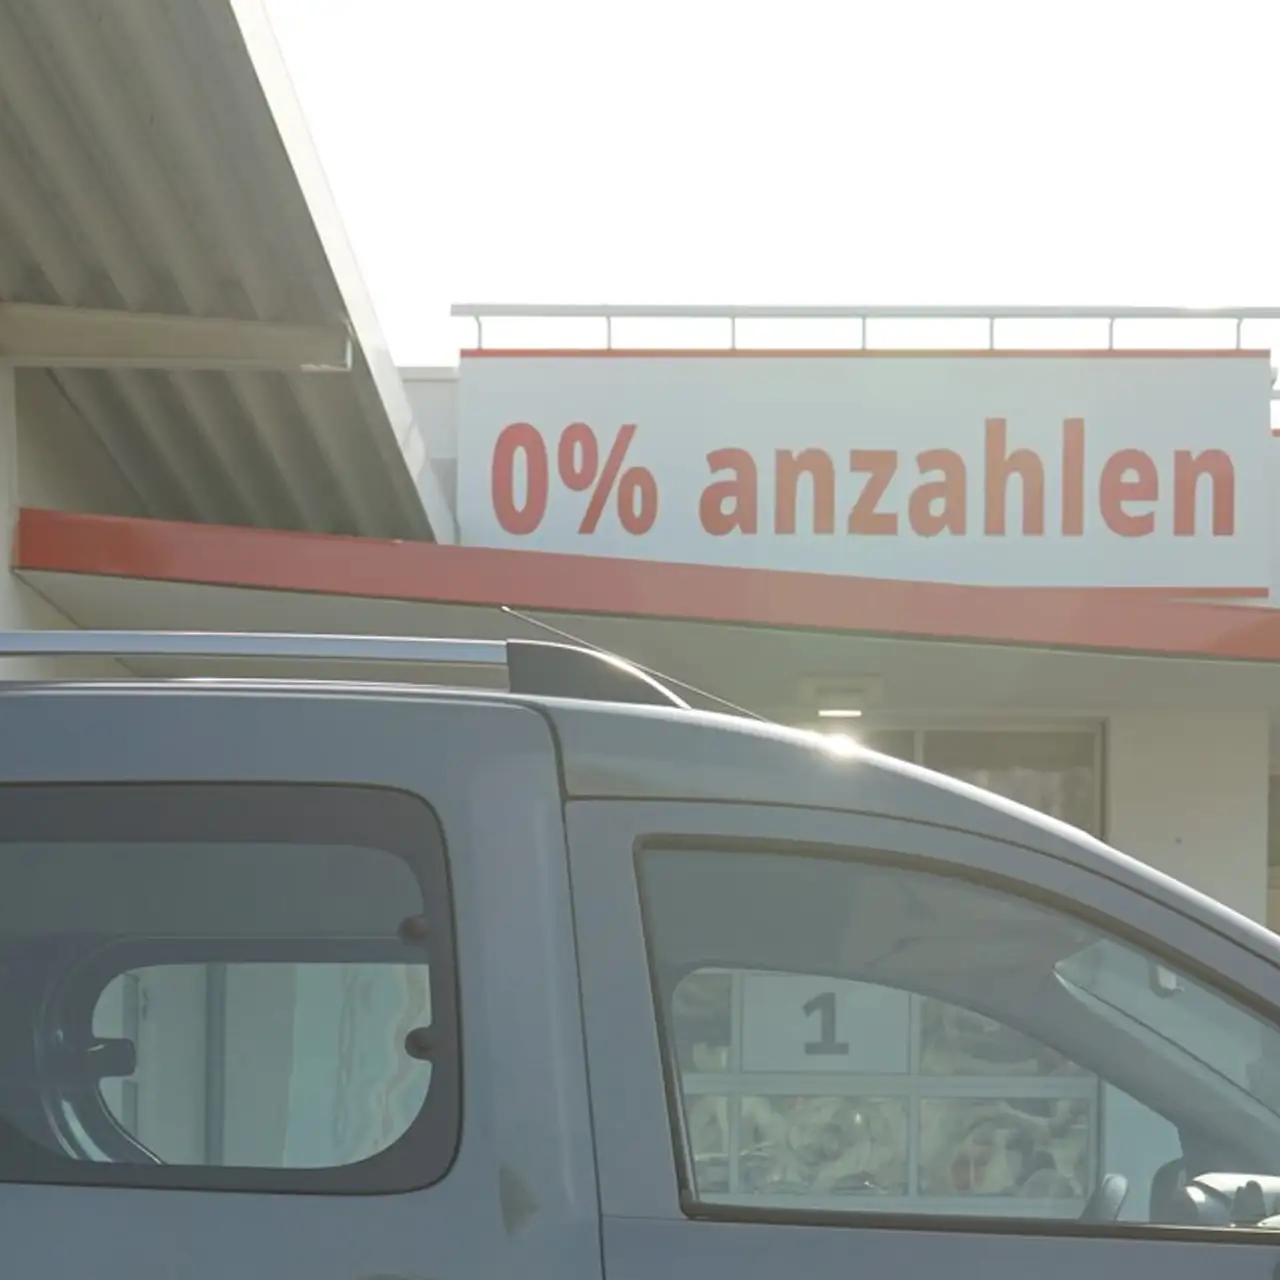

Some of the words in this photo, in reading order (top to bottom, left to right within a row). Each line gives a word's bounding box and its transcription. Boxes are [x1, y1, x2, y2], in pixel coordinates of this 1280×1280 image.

[492, 422, 658, 534] 0%
[699, 418, 1234, 537] anzahlen
[802, 991, 851, 1055] 1
